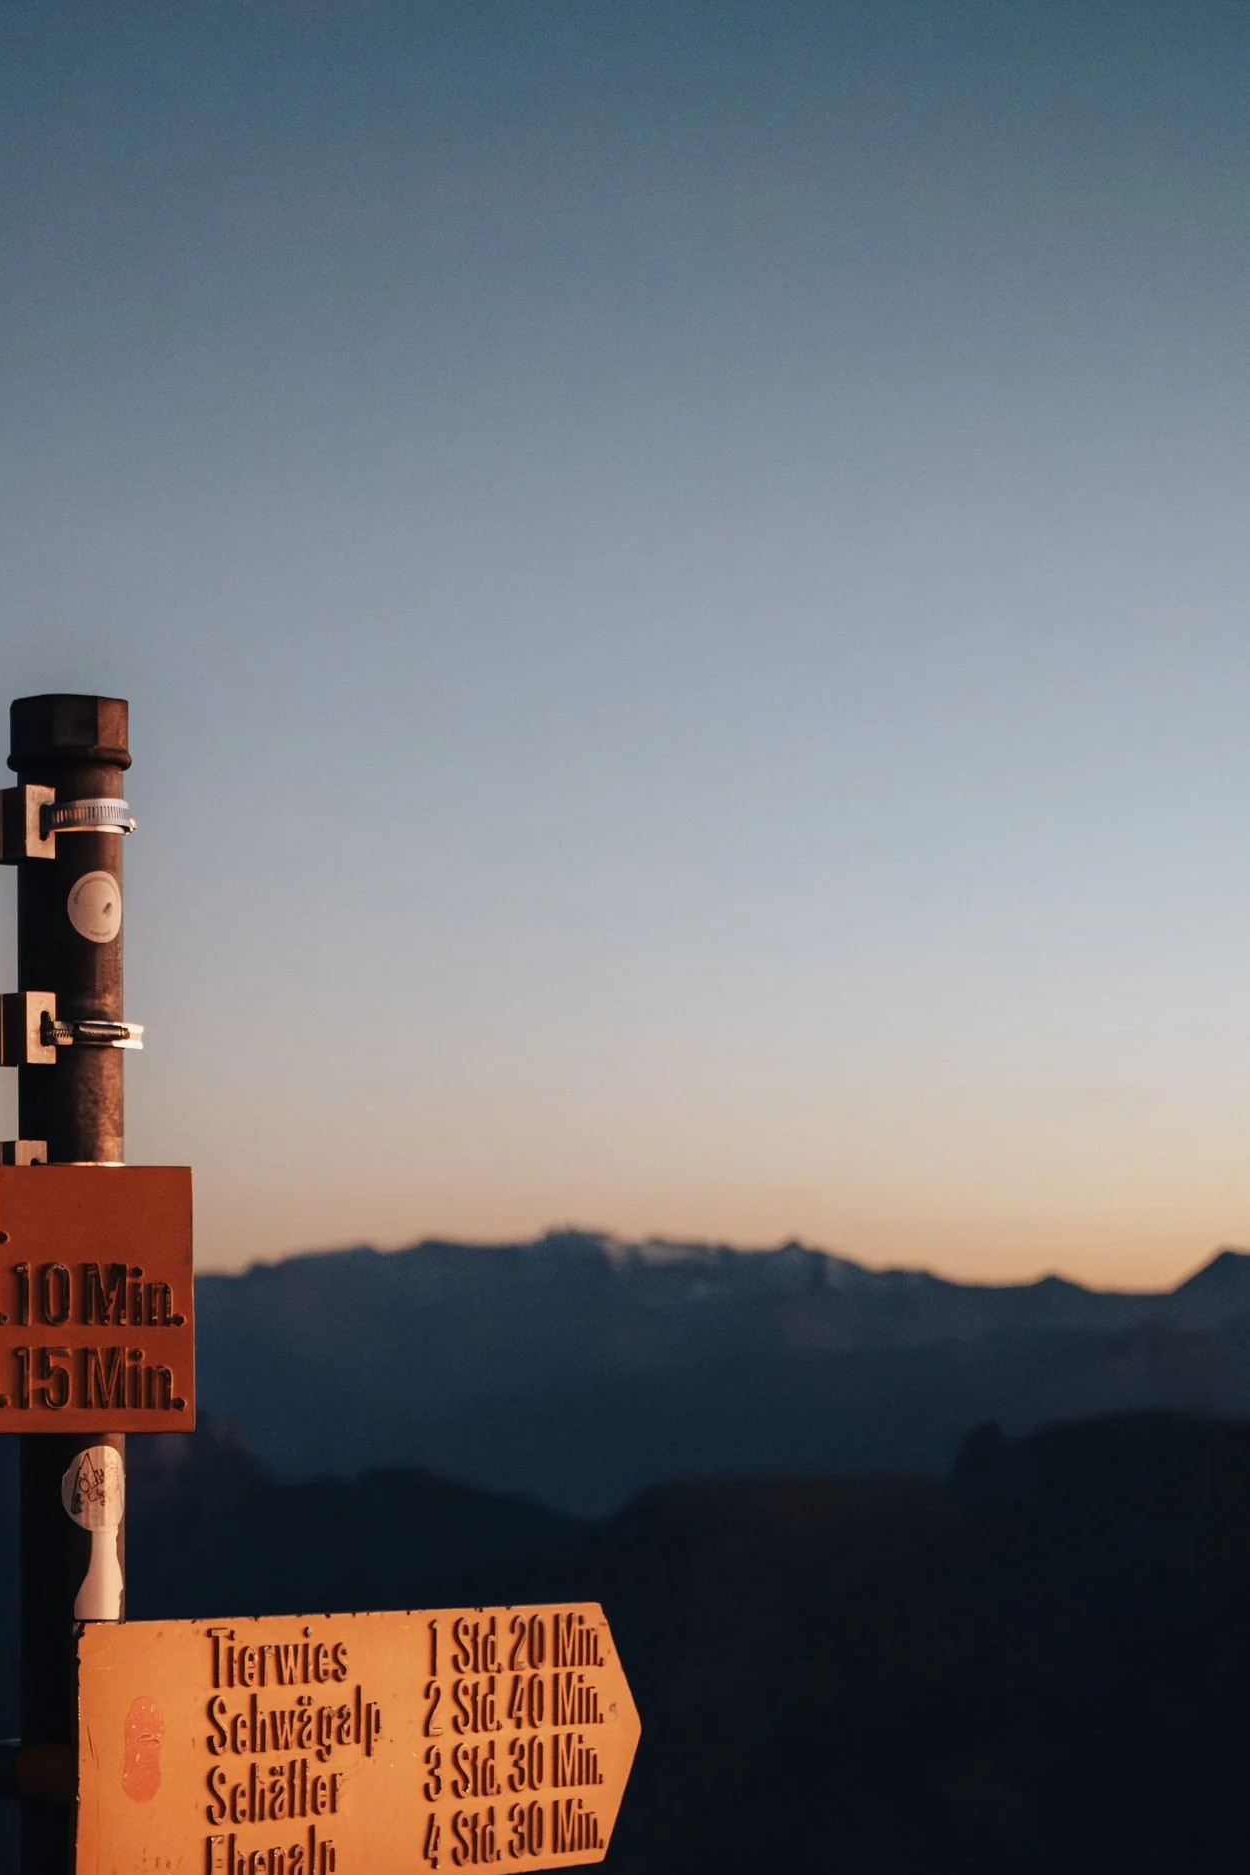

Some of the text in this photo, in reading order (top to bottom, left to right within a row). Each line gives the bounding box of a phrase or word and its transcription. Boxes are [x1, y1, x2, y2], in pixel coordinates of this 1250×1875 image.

[206, 1612, 606, 1688] Tierwies 1 Std. 20 Min.
[206, 1671, 605, 1763] Schwägalp 2 Std. 40 Min.
[206, 1733, 605, 1825] Schäfler 3 Std. 30 Min.
[422, 1812, 441, 1870] 4
[451, 1805, 503, 1867] Std.
[507, 1800, 544, 1859] 30
[552, 1798, 605, 1854] Min.
